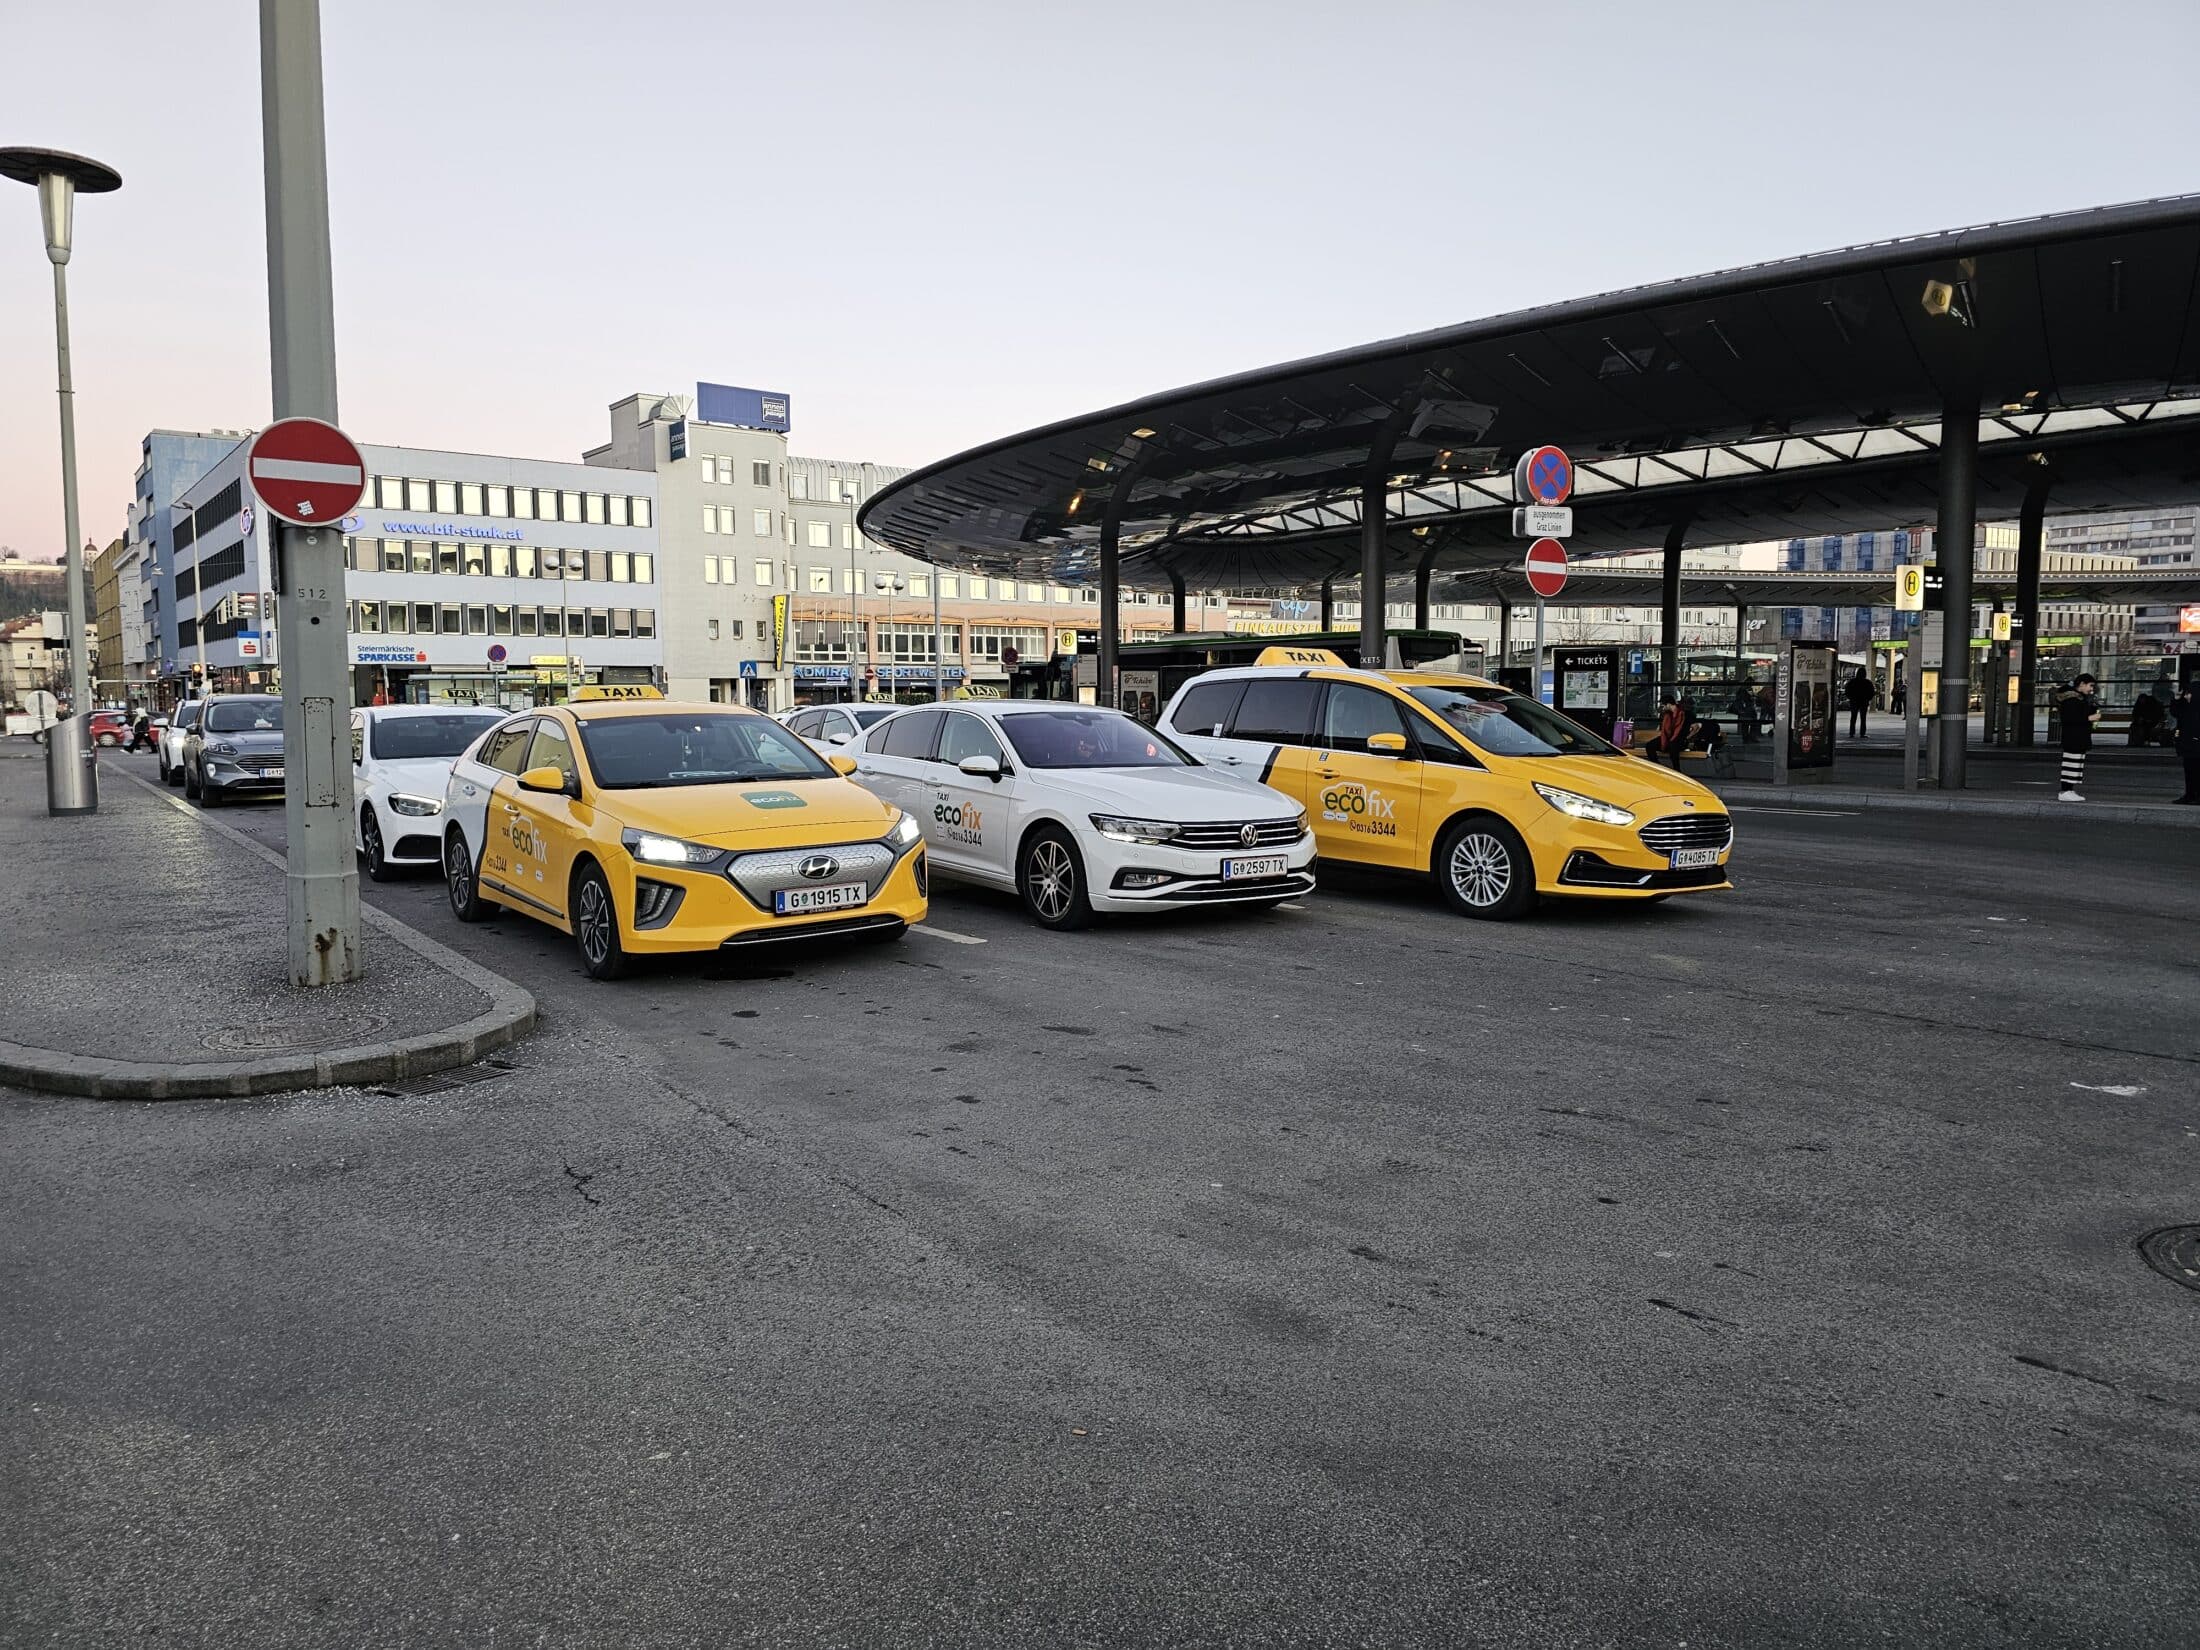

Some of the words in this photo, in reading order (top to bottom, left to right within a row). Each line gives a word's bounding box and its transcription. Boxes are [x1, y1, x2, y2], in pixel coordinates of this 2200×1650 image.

[383, 521, 524, 540] www.bfi-stmk.at
[298, 588, 327, 599] 512
[357, 645, 415, 653] Steiermärkische
[357, 653, 416, 662] SPARKASSE
[1285, 651, 1327, 663] TAXI
[1577, 656, 1608, 665] TICKETS
[969, 686, 998, 698] TAXI
[1778, 665, 1788, 707] TICKETS
[450, 690, 476, 698] TAXI
[599, 687, 642, 698] TAXI
[936, 792, 950, 801] TAXI
[1345, 786, 1363, 795] TAXI
[1324, 789, 1396, 819] ecofix
[933, 801, 982, 830] ecofix
[1371, 820, 1396, 837] 3344
[1233, 863, 1239, 875] G
[1246, 860, 1271, 875] 2597
[1273, 860, 1284, 872] TX
[791, 893, 799, 908] G
[810, 888, 841, 906] 1915
[844, 886, 861, 902] TX
